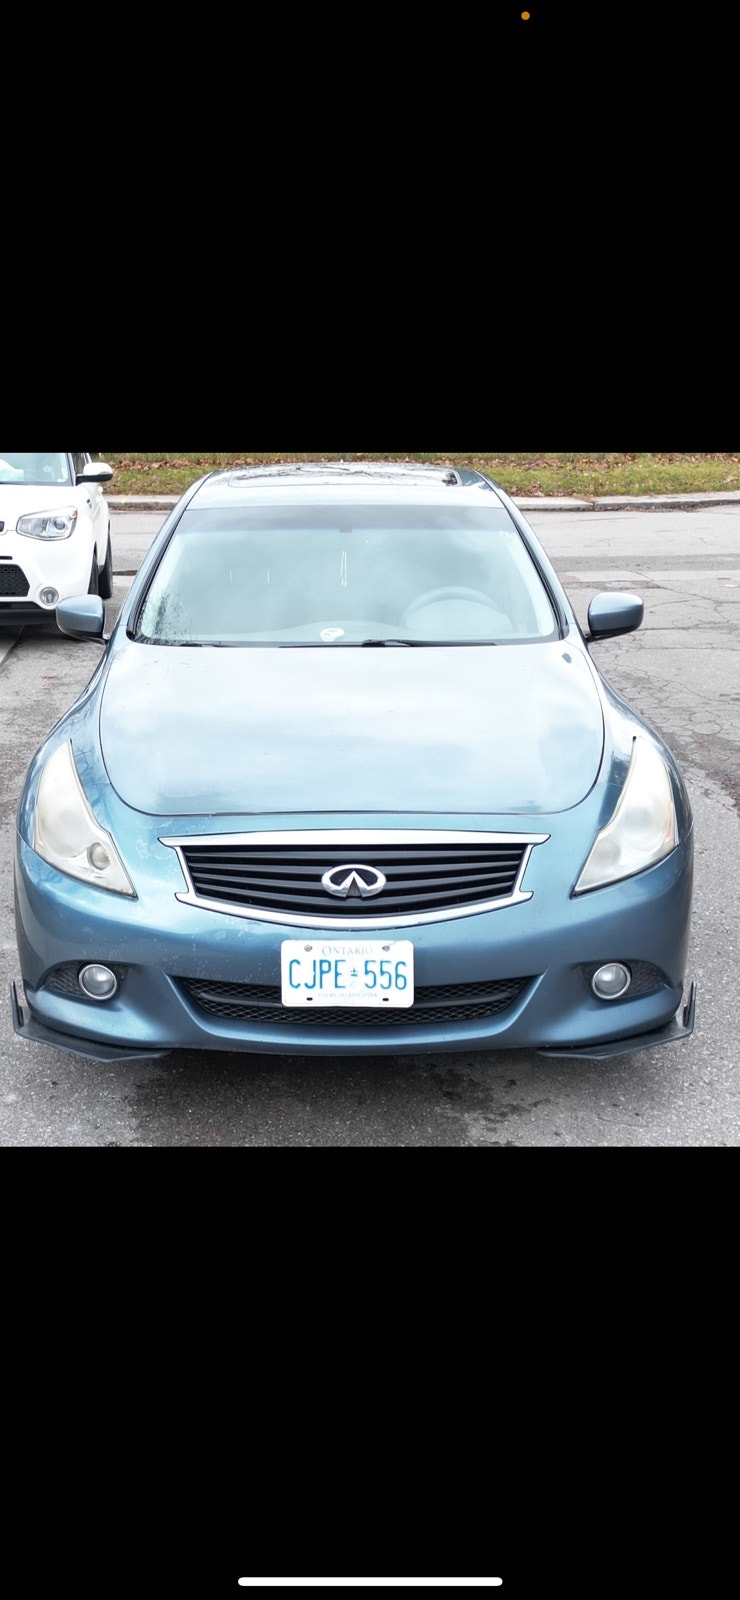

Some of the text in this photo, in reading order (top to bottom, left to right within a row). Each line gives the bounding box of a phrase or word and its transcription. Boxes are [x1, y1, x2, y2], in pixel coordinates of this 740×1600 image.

[321, 945, 373, 956] ONTARIO
[289, 959, 408, 990] CJPE 556
